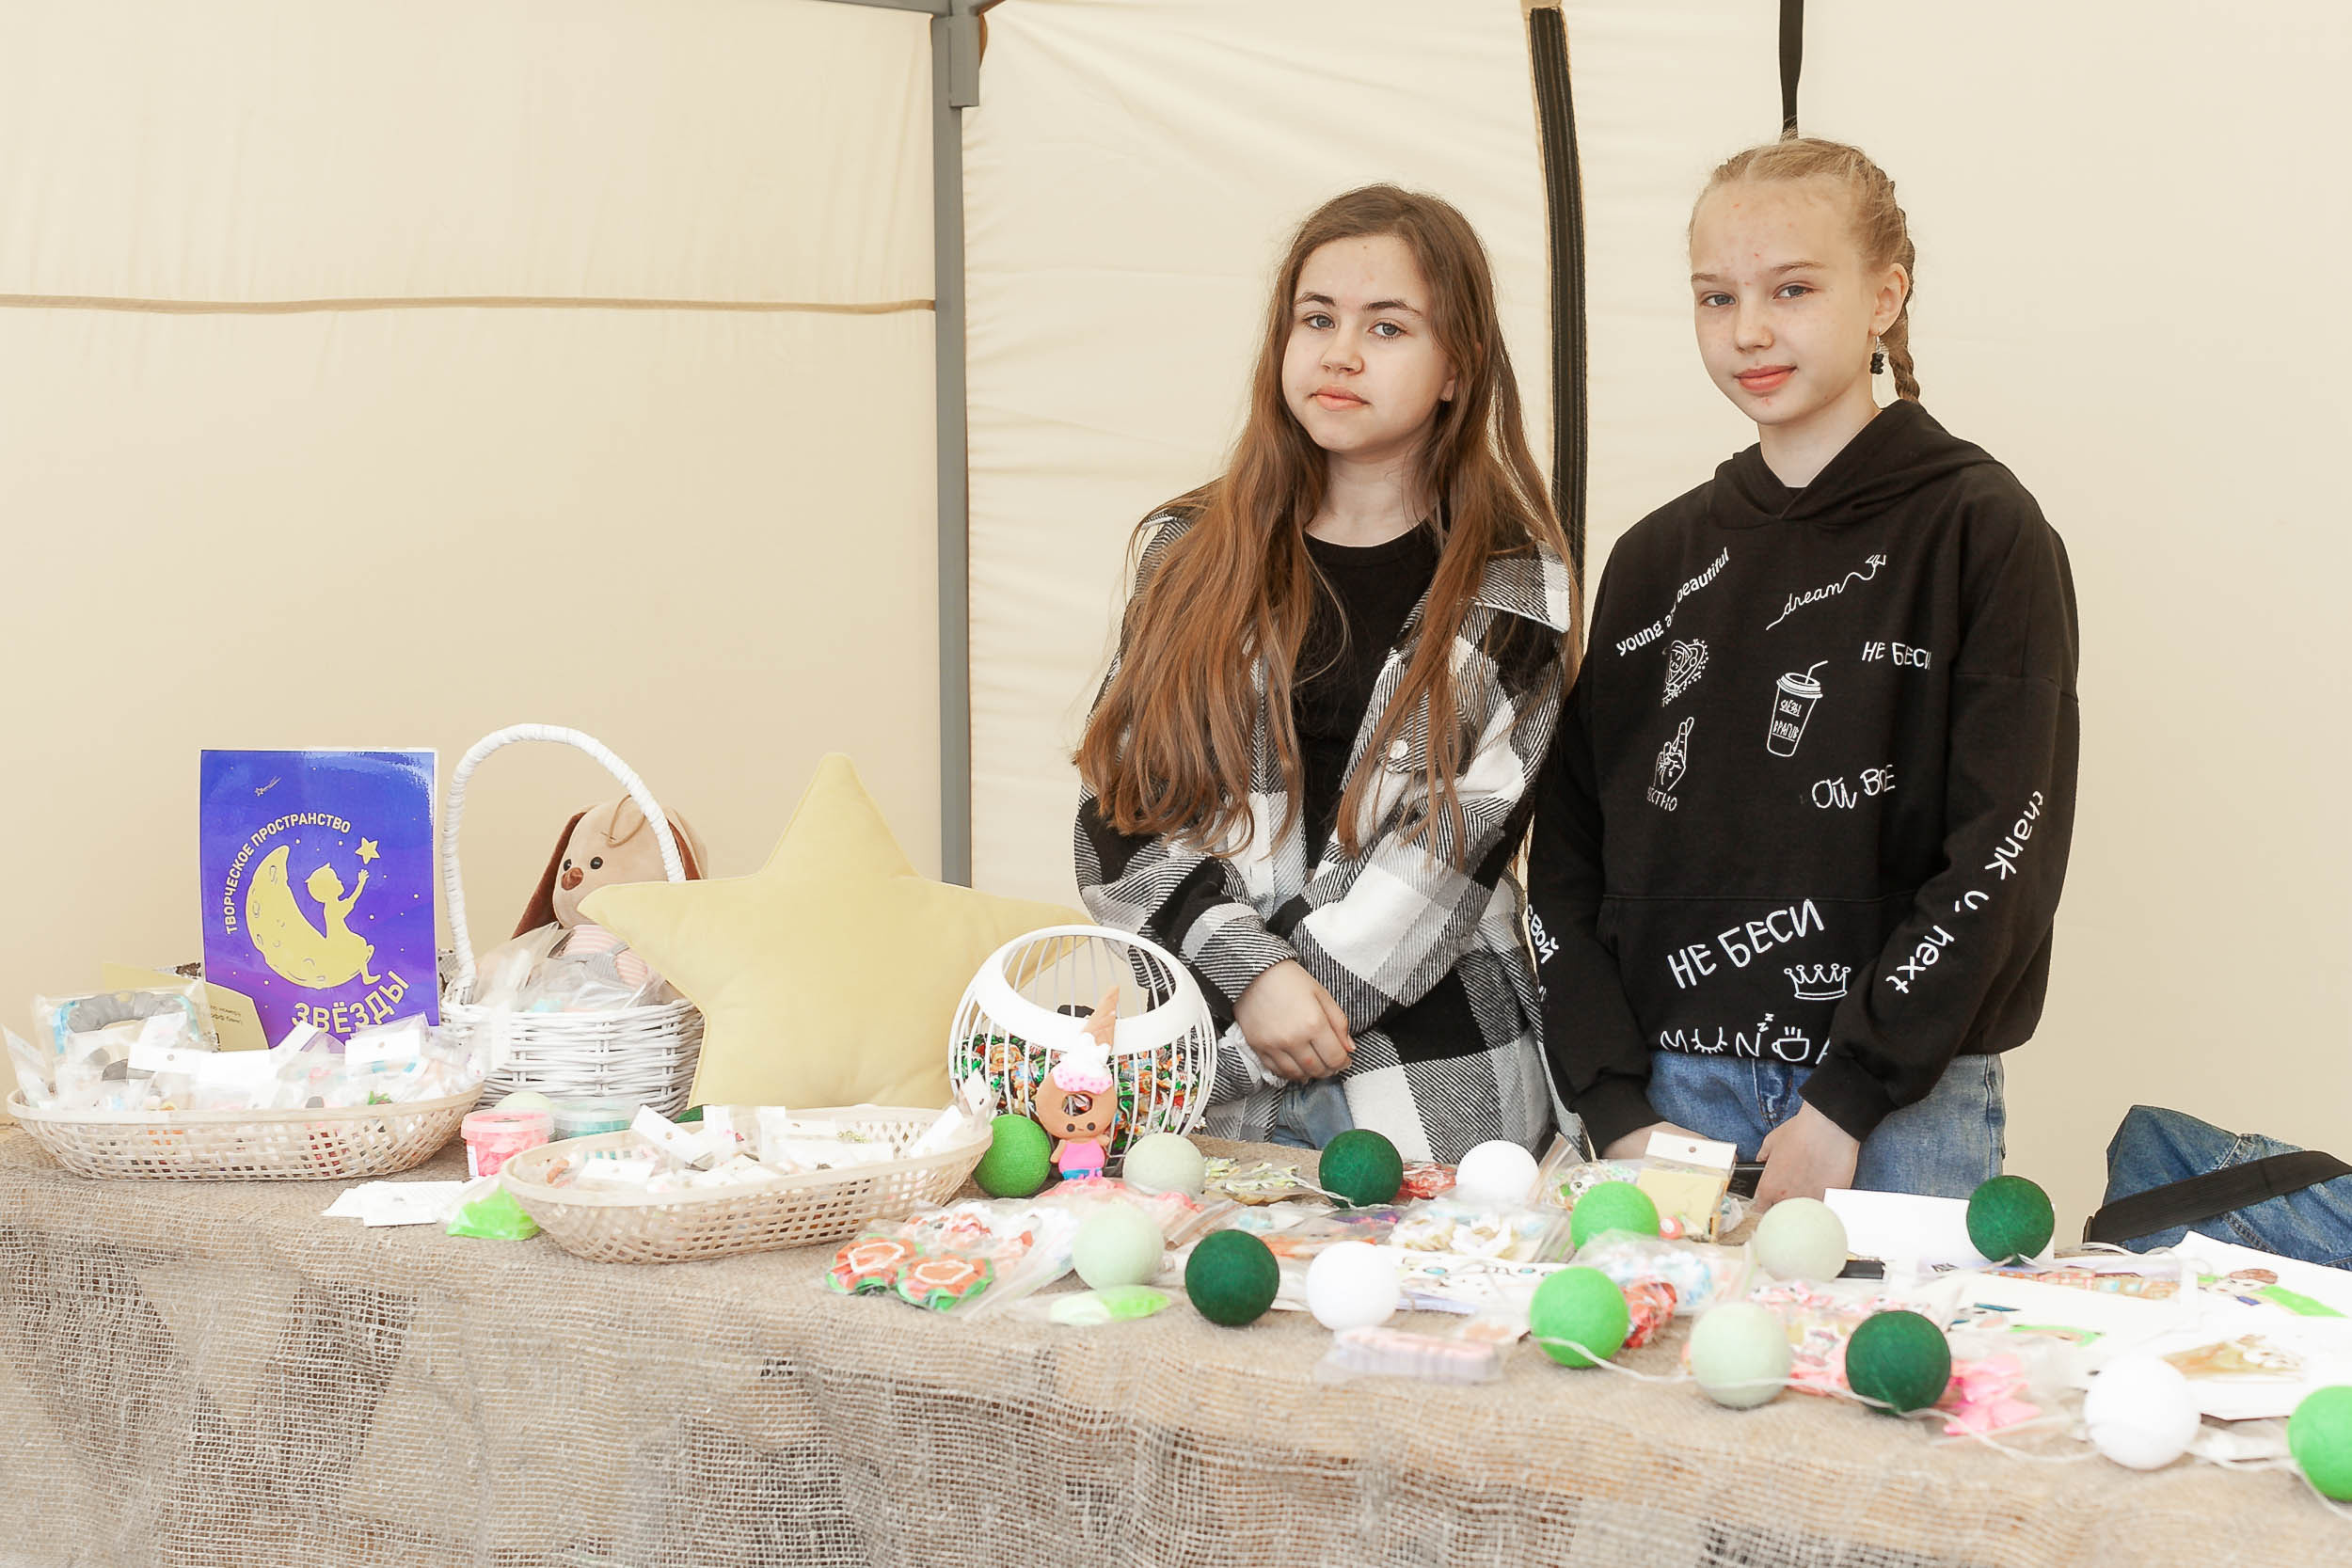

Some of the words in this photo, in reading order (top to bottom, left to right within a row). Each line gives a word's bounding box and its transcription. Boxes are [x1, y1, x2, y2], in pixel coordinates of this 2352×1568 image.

[1783, 582, 1845, 615] dream
[1615, 620, 1664, 657] young
[1861, 641, 1886, 662] НЕ
[223, 843, 255, 935] ТВОРЧЕСКОЕ
[250, 812, 352, 847] ПРОСТРАНСТВО
[1667, 943, 1717, 989] НЕ
[1717, 898, 1825, 968] БЕСИ
[1885, 925, 1955, 994] next
[291, 970, 410, 1034] ЗВЁЗДЫ
